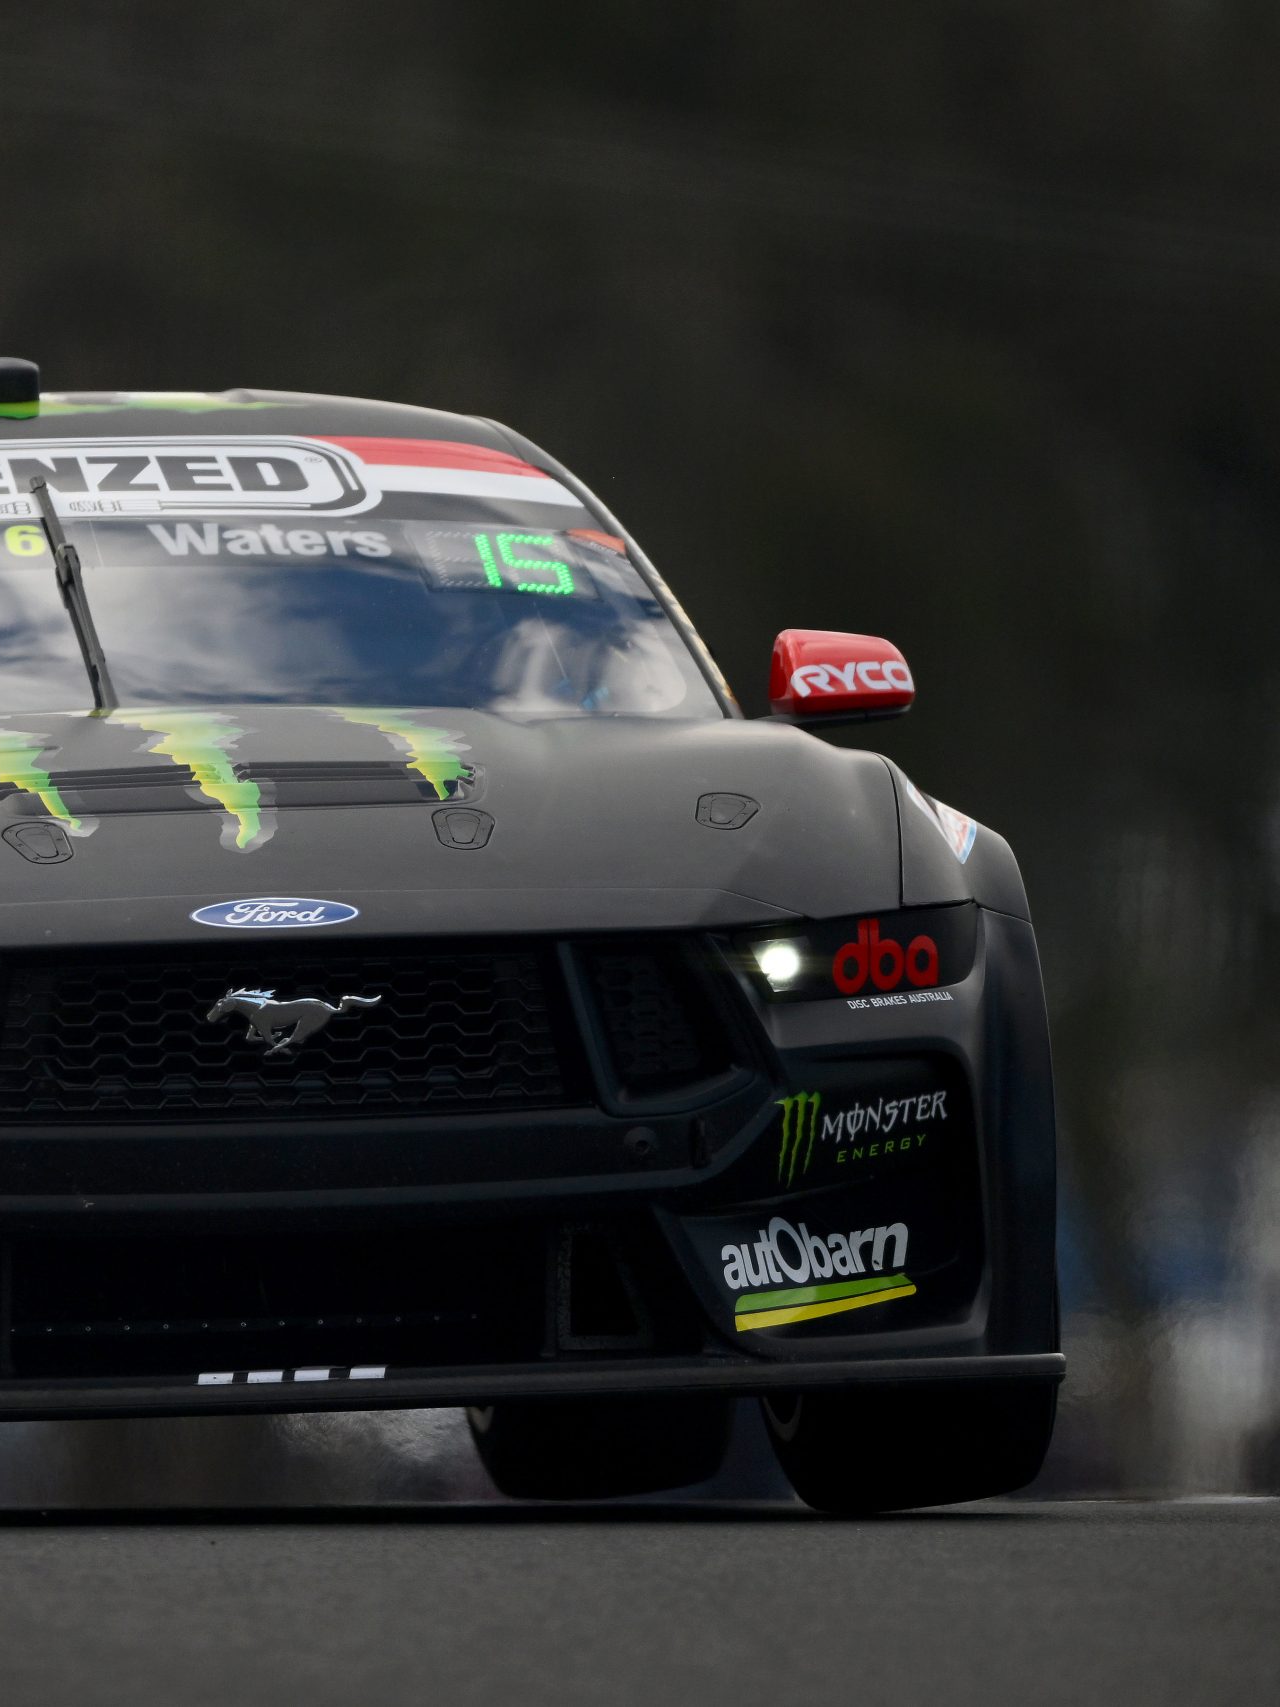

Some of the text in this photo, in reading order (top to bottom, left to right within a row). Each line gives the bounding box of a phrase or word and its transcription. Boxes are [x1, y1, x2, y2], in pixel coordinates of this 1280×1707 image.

[4, 524, 47, 557] 6
[147, 522, 392, 558] Waters
[474, 532, 575, 595] 15
[791, 659, 914, 697] RYCO
[225, 902, 324, 924] Ford
[832, 918, 939, 995] dba
[847, 991, 953, 1010] DISC BRAKES AUSTRALIA
[821, 1091, 948, 1143] MONSTER
[836, 1134, 928, 1164] ENERGY
